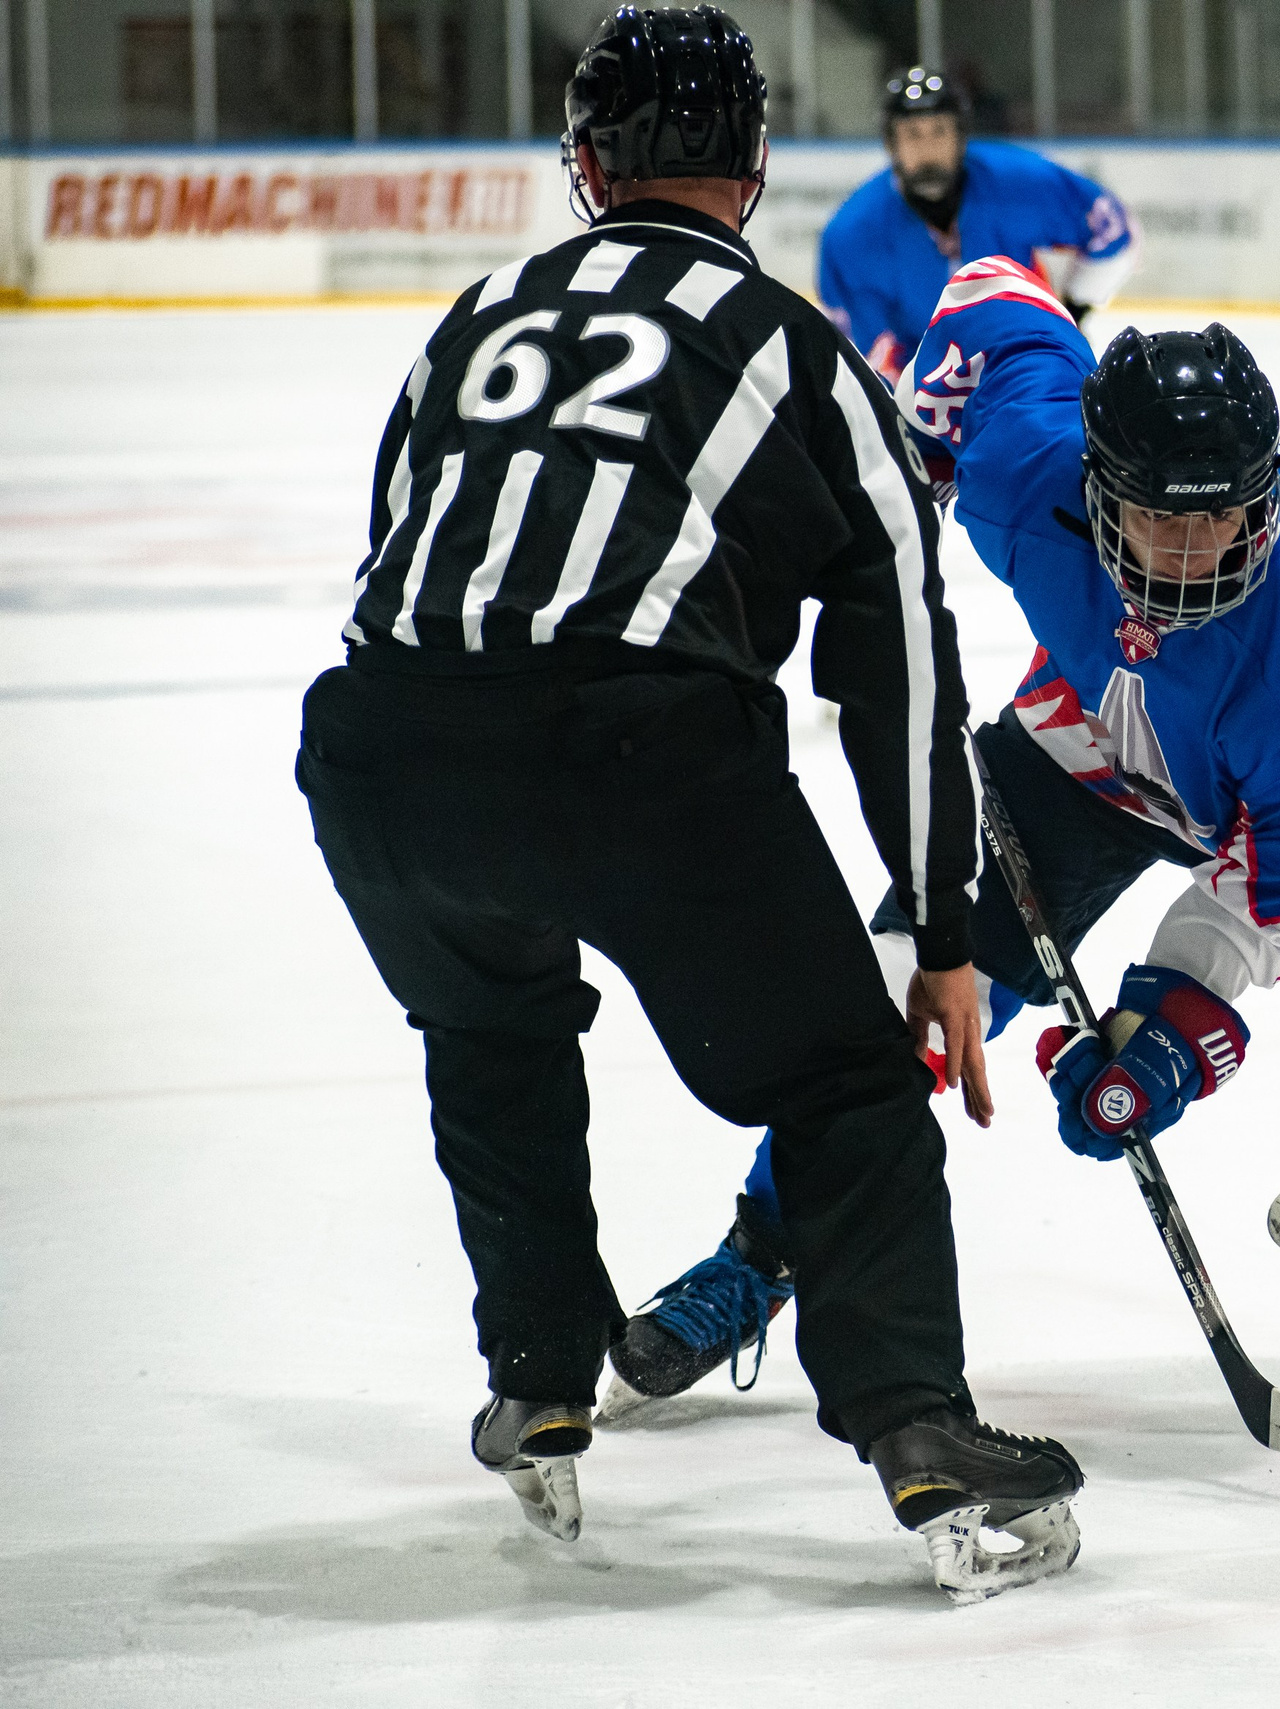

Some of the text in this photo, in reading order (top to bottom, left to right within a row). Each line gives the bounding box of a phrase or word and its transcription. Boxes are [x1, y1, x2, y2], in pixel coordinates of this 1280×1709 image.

[457, 309, 671, 441] 62
[1164, 482, 1232, 494] BAUER
[1197, 1027, 1240, 1093] WA
[1161, 1226, 1186, 1273] classic
[1181, 1271, 1206, 1310] SPR
